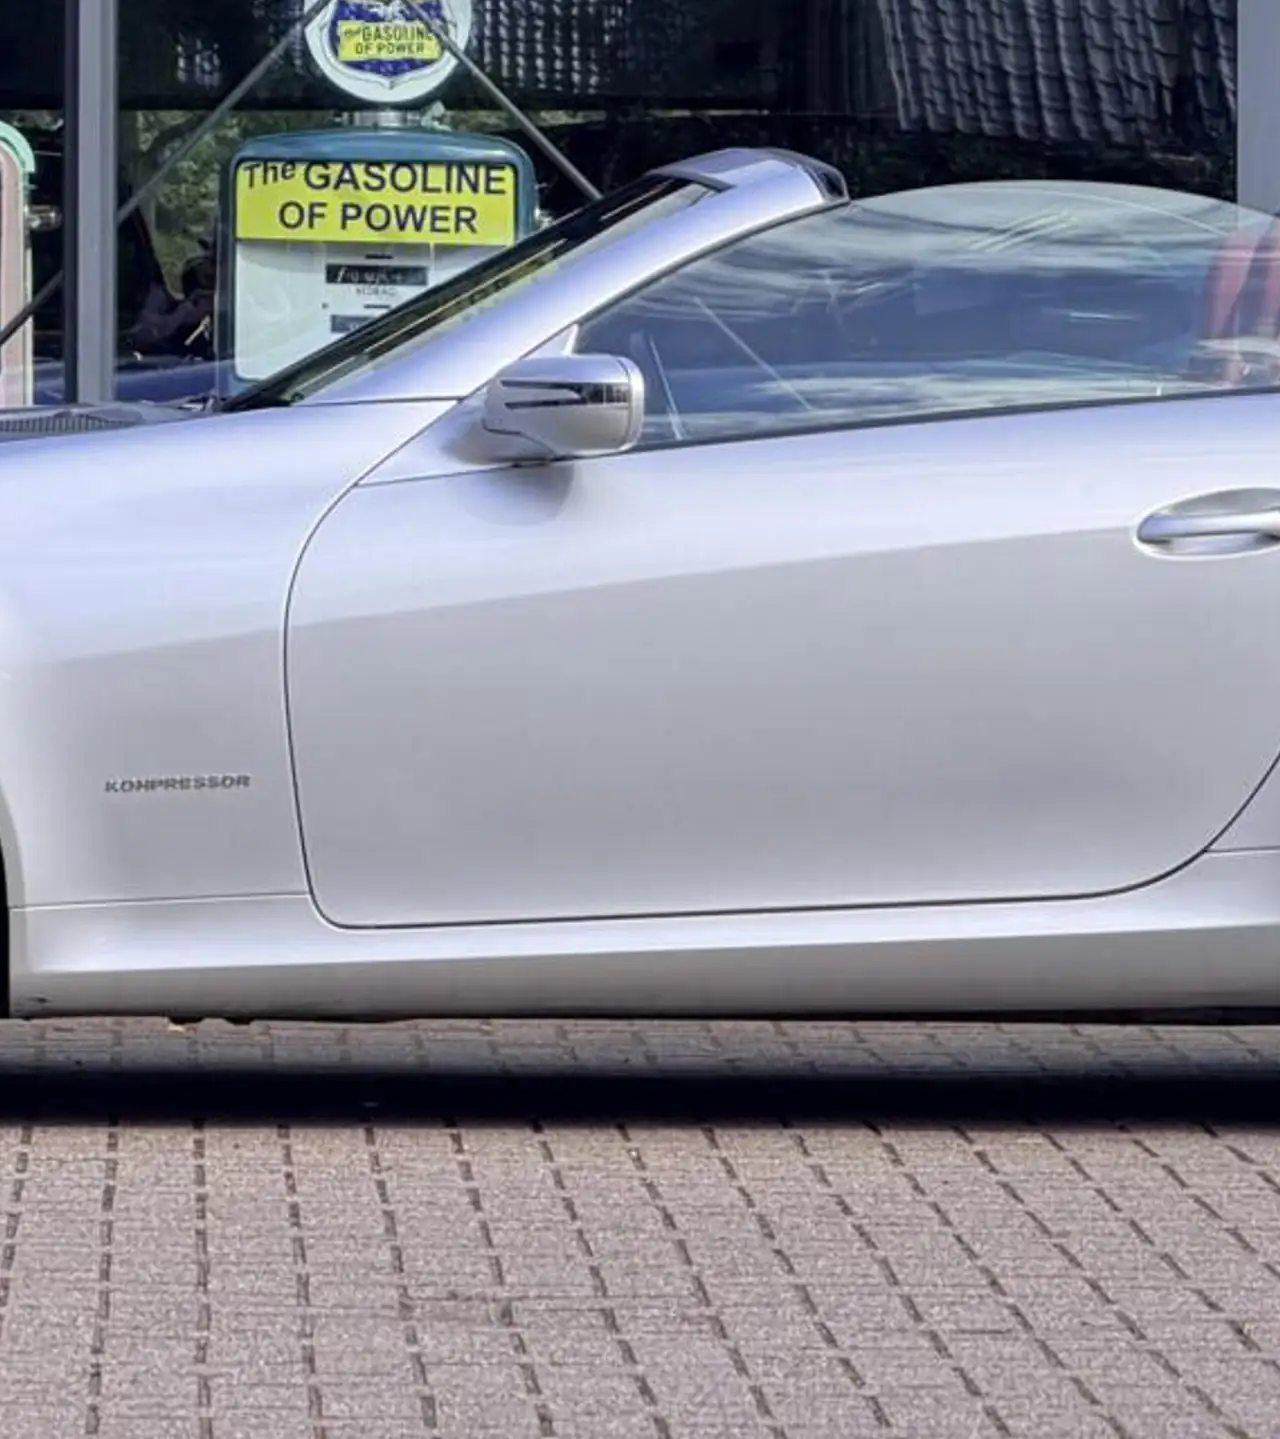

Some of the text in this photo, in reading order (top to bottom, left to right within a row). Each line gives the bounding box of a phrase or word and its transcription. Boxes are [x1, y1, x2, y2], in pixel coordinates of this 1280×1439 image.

[362, 24, 433, 42] GASOLIN
[243, 161, 506, 195] The GASOLINE
[278, 200, 478, 234] OF POWER
[104, 774, 252, 794] KOMPRESSOR
